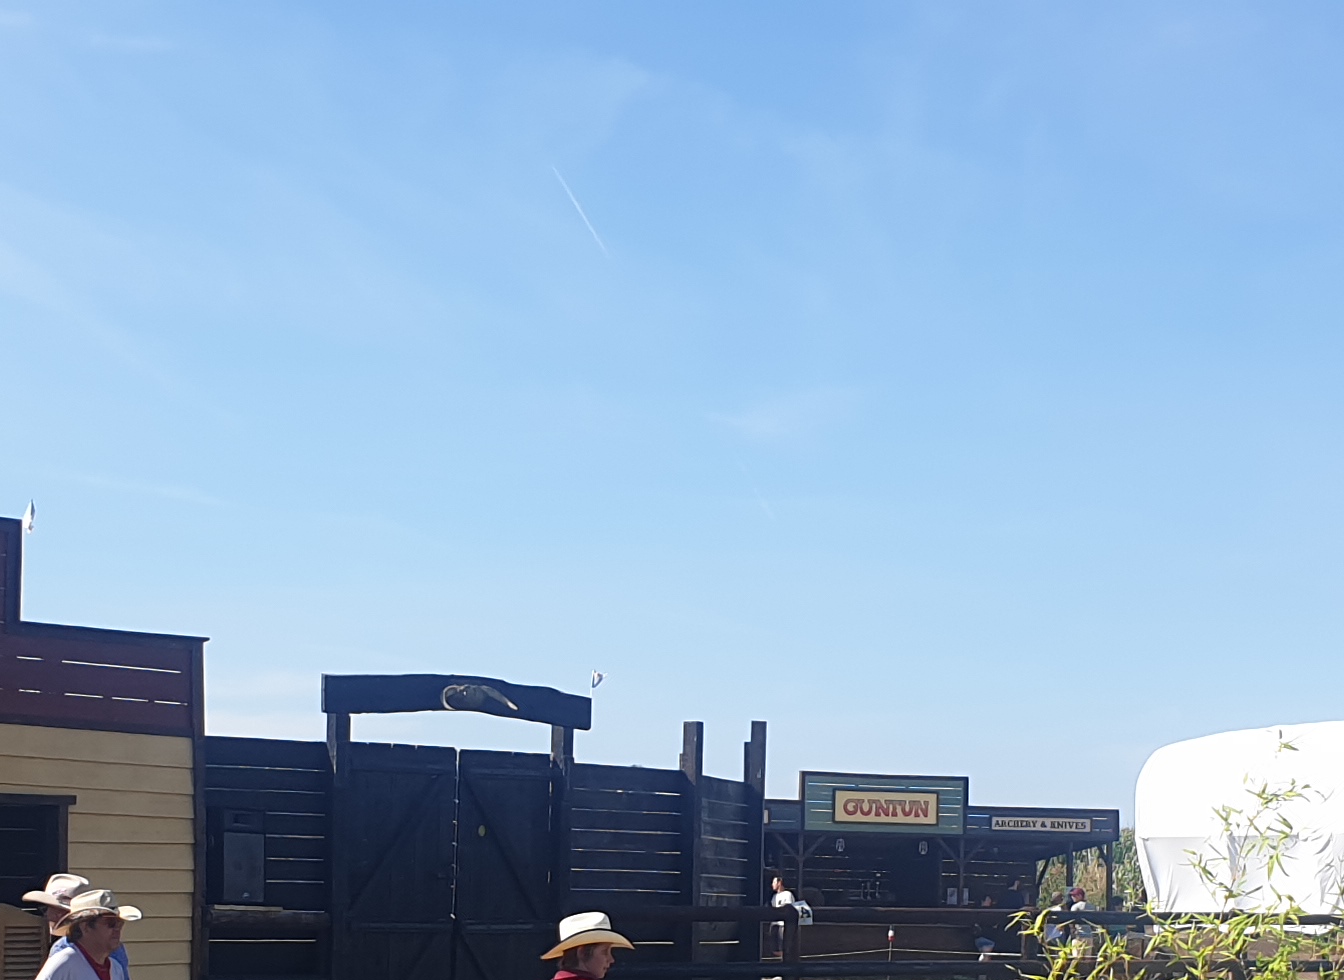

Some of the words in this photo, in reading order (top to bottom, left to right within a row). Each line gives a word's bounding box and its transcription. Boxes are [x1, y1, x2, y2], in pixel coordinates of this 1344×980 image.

[994, 819, 1038, 828] ARCHERY
[1040, 820, 1047, 829] &
[1049, 820, 1086, 830] KNIVES
